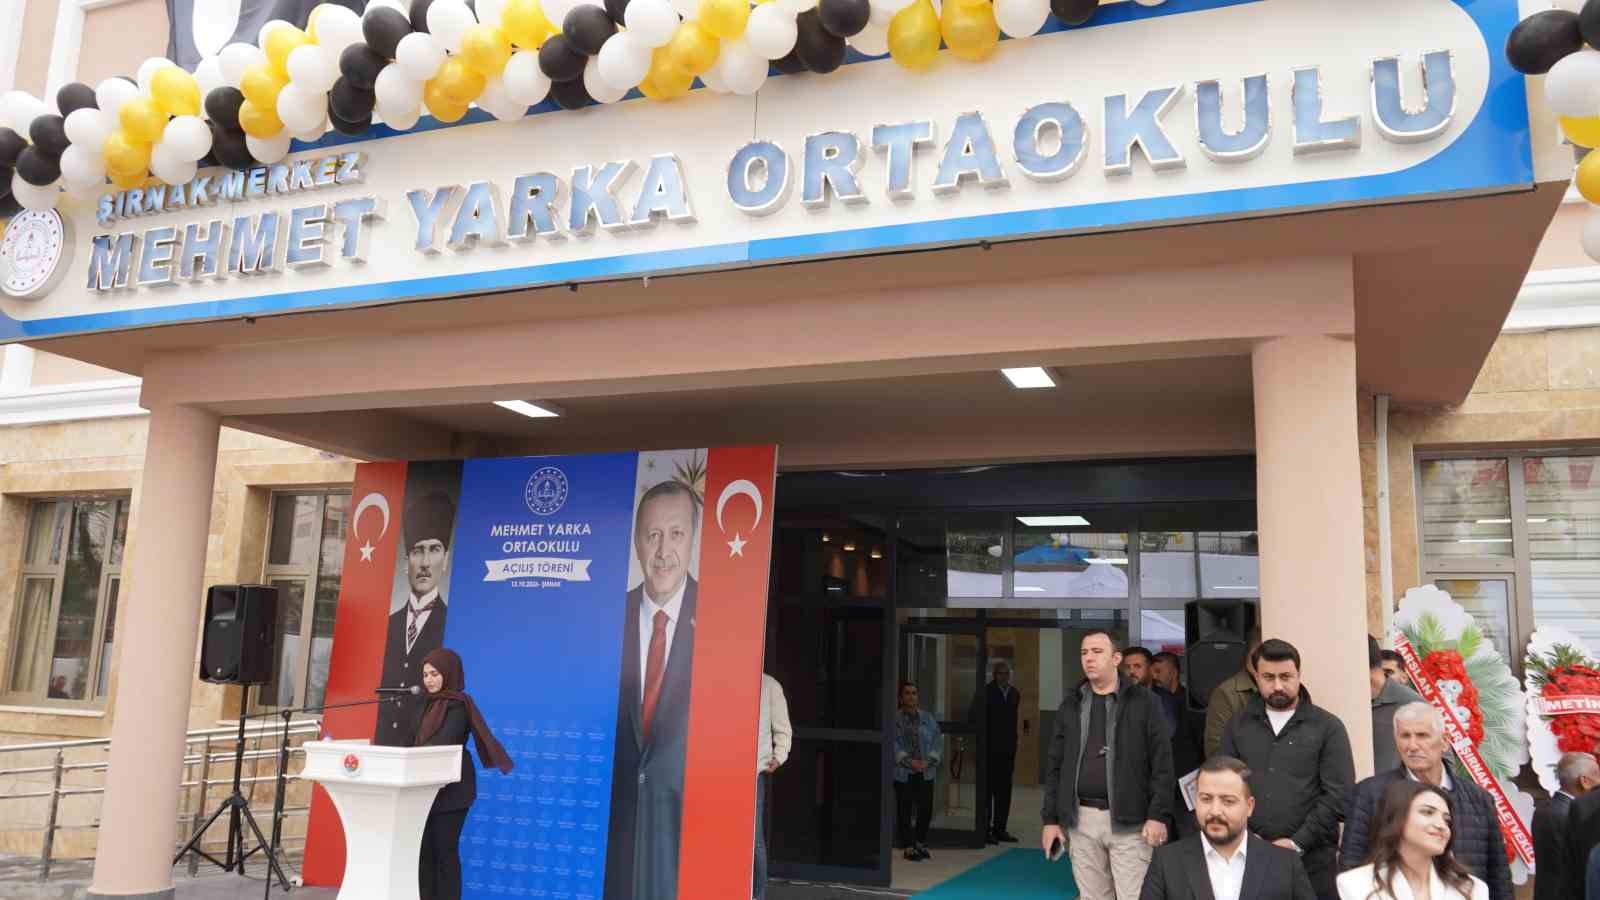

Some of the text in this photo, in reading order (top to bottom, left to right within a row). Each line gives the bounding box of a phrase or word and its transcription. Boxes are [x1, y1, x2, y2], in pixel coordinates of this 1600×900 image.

[86, 195, 380, 291] MEHMET
[405, 152, 697, 254] YARKA
[726, 48, 1459, 217] ORTAOKULU
[96, 151, 362, 223] ŞIRNAK-MERKEZ
[490, 523, 592, 537] MEHMET YARKA
[502, 540, 580, 553] ORTAOKULU
[502, 561, 574, 574] AÇILIŞ TÖRENİ
[1399, 645, 1434, 696] ARSLAN
[1430, 695, 1464, 741] TATAR
[1460, 746, 1492, 788] ŞIRNAK
